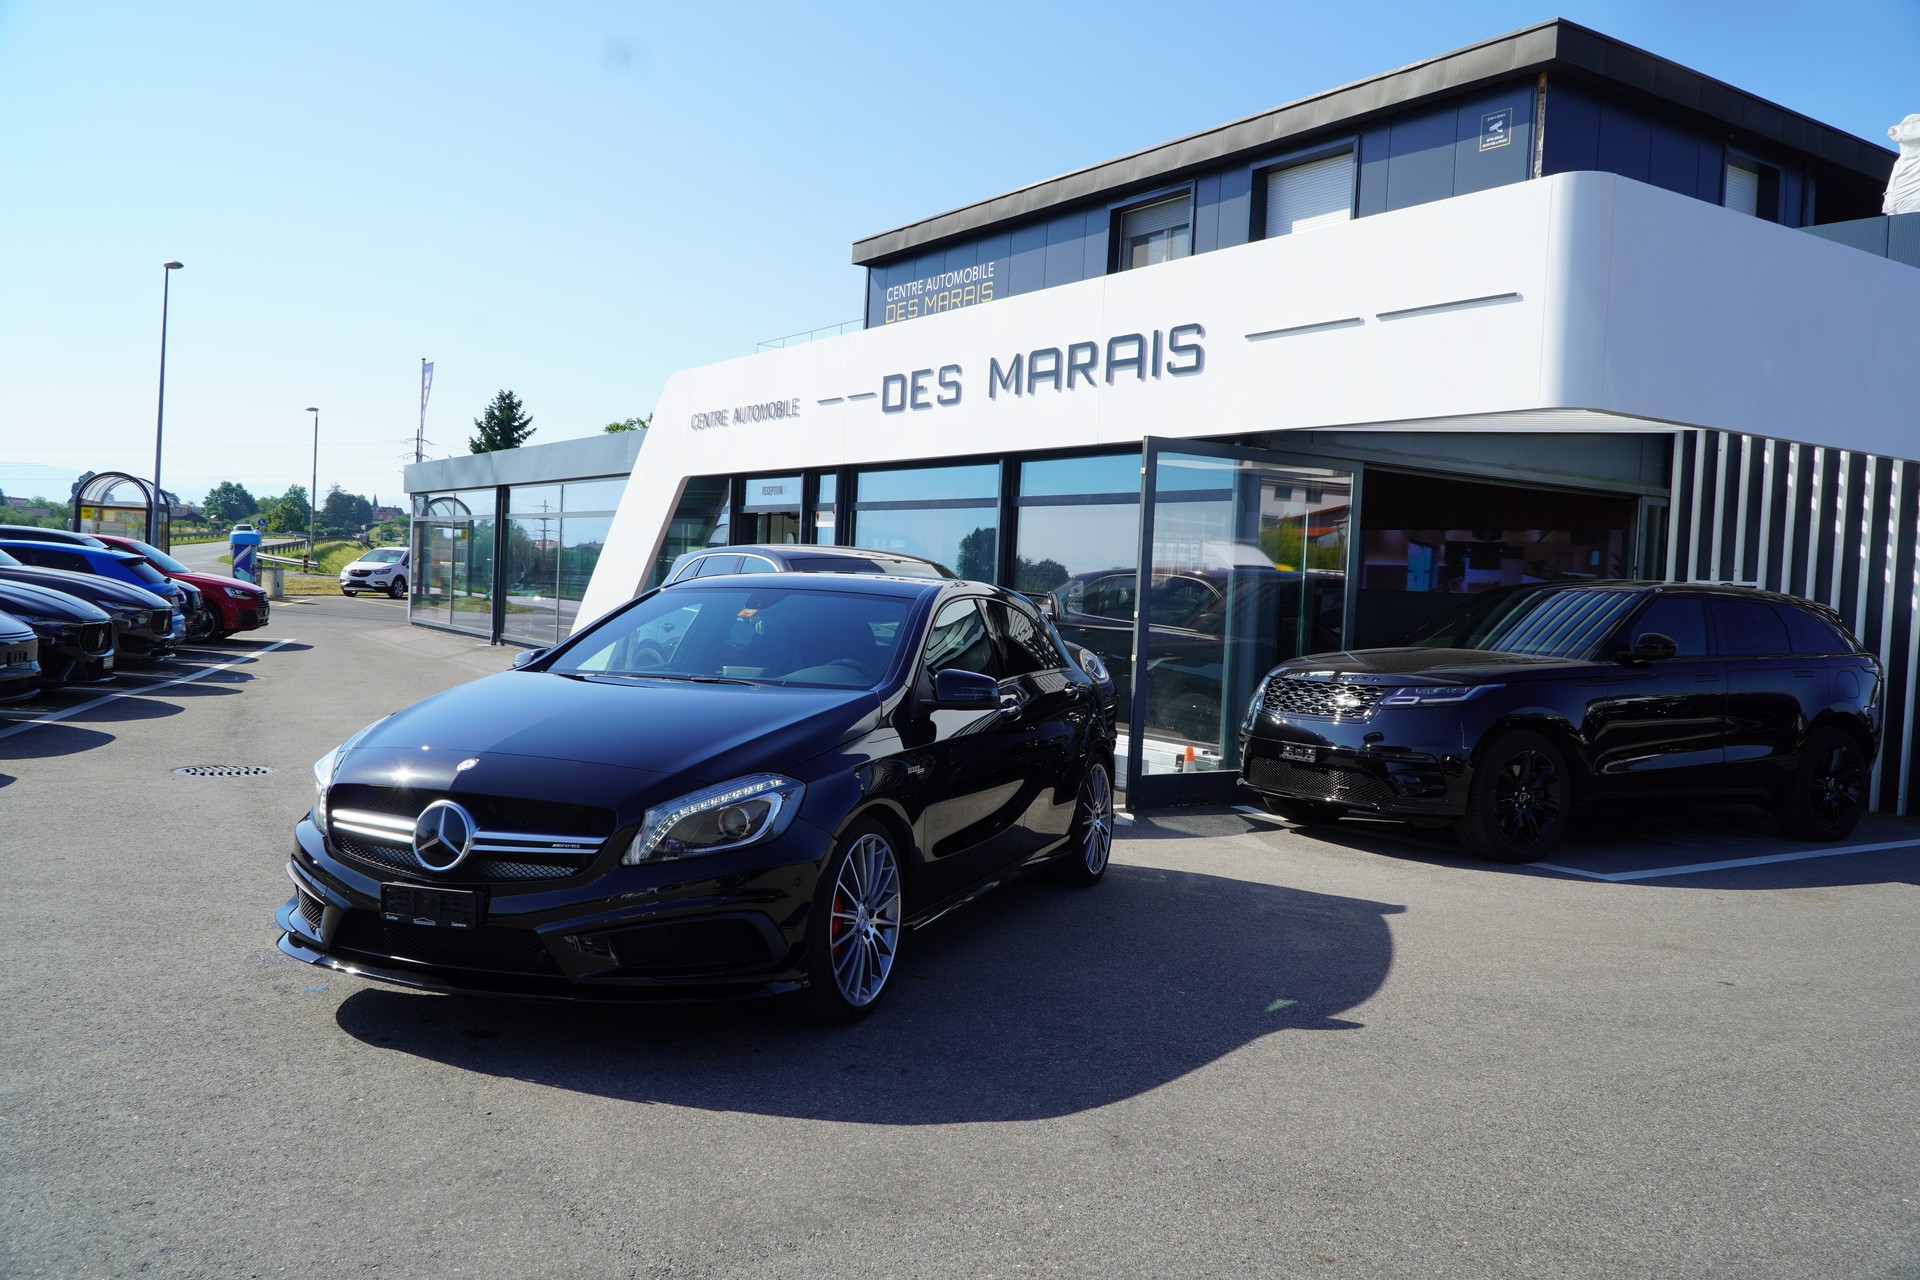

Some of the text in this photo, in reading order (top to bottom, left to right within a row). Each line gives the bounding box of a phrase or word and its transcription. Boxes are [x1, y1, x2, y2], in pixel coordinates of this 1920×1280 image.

[885, 281, 994, 324] DES MARAIS
[886, 261, 995, 302] CENTRE AUTOMOBILE
[691, 323, 1205, 431] CENTRE AUTOMOBILE DES MARAIS
